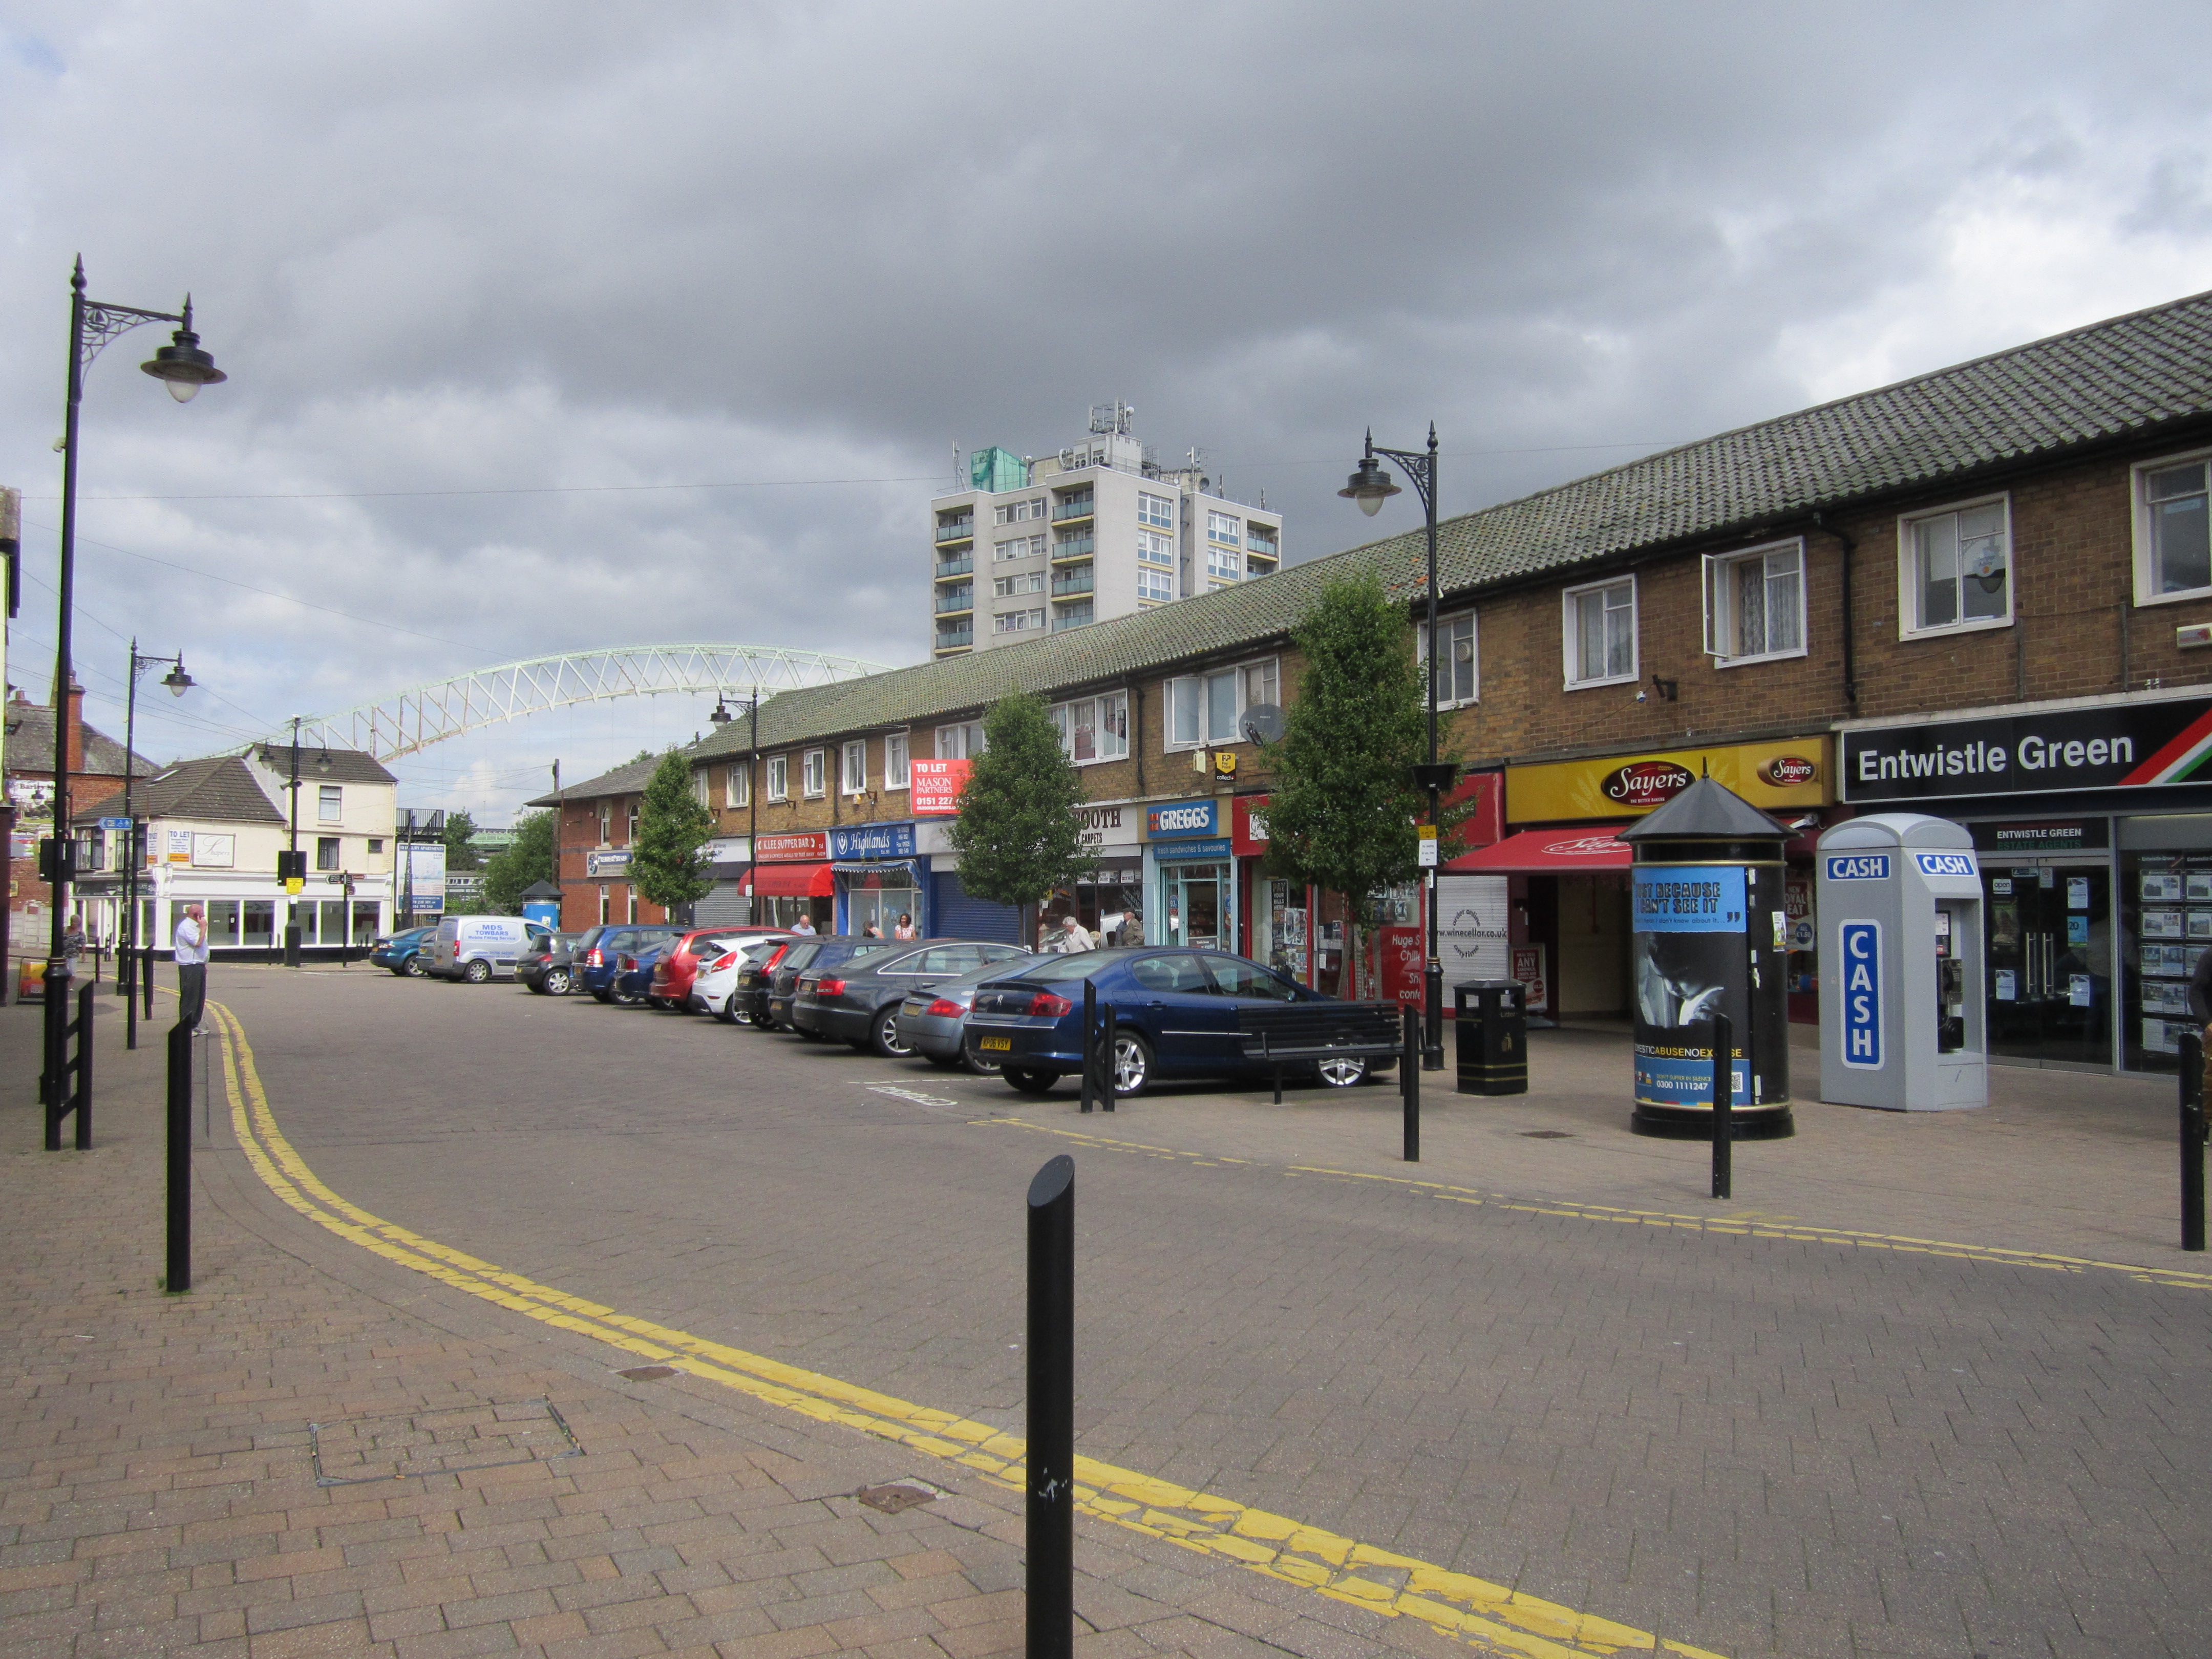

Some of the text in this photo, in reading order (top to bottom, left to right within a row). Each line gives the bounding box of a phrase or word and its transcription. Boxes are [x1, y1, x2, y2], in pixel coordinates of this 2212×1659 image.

[1859, 736, 2132, 780] Entwistle Green
[916, 763, 947, 773] TO LET
[1774, 760, 1811, 778] Sayers
[917, 777, 952, 786] MASON
[1610, 768, 1687, 798] Sayers
[1160, 806, 1209, 831] GREGGS
[1081, 833, 1102, 843] CARPETS
[1997, 828, 2081, 839] ENTWISTLE GREEN
[777, 838, 798, 849] SUPPER
[798, 838, 809, 848] BAR
[850, 829, 890, 856] Highlands
[1169, 845, 1196, 854] sandwiches
[1202, 844, 1226, 852] savouries
[1997, 840, 2081, 850] ESTATE AGENTS
[1833, 857, 1883, 877] CASH
[1923, 856, 1969, 874] CASH
[1656, 882, 1720, 898] BECAUSE
[1640, 898, 1669, 914] CAN'T
[1673, 898, 1698, 913] SEE
[1703, 898, 1718, 913] IT
[1453, 909, 1481, 927] order online
[1427, 927, 1507, 938] w.winecellar.co.uk
[1392, 934, 1413, 948] Huge
[1454, 945, 1479, 959] anytime
[1518, 958, 1535, 967] ANY
[1849, 930, 1873, 1056] CASH
[1676, 1081, 1708, 1090] 1111247
